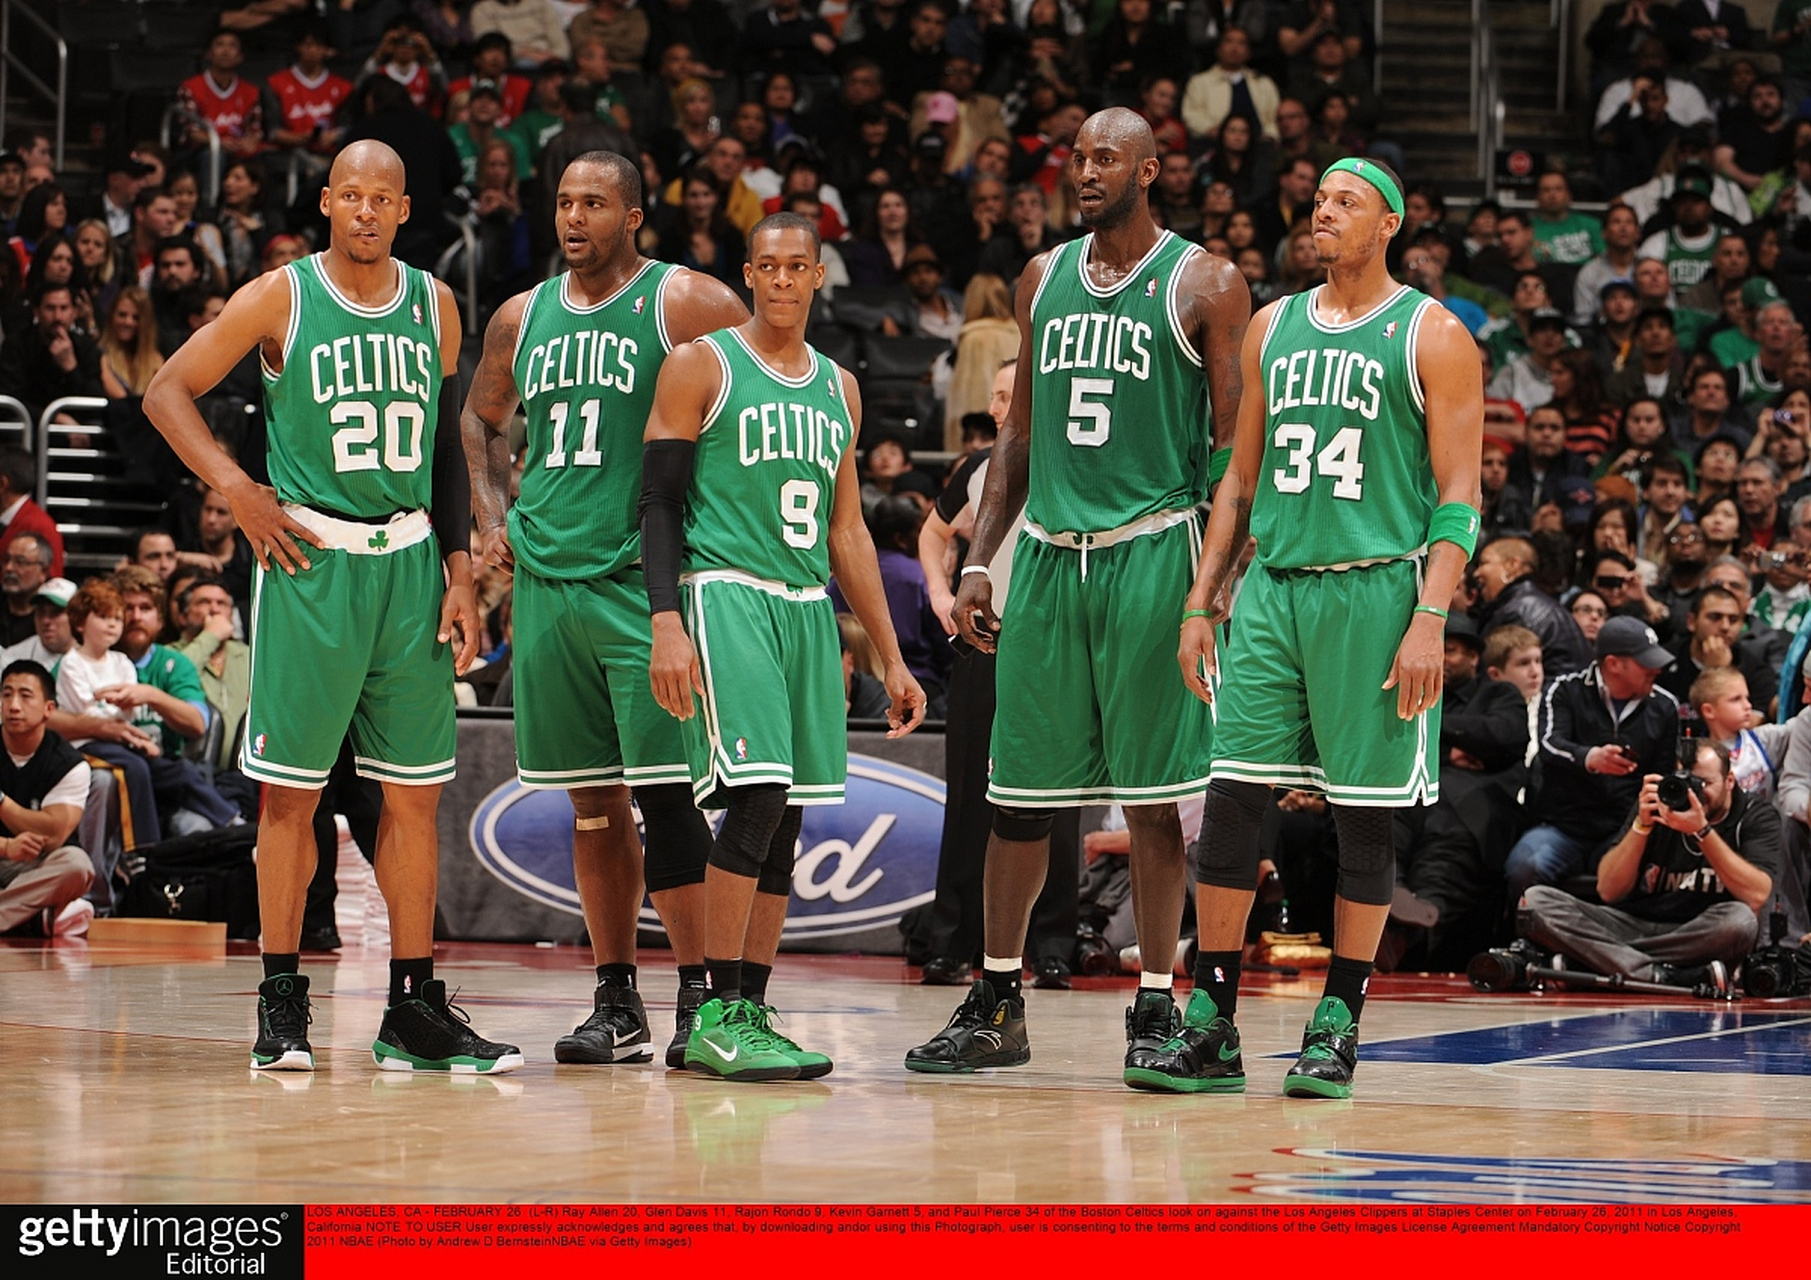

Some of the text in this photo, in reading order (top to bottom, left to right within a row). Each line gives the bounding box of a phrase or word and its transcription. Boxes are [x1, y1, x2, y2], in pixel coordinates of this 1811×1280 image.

[311, 333, 432, 404] CELTICS
[525, 330, 638, 401] CELTICS
[1040, 312, 1153, 381] CELTICS
[1066, 377, 1115, 447] 5
[1269, 348, 1385, 421] CELTICS
[329, 401, 425, 473] 20
[545, 398, 603, 469] 11
[738, 402, 845, 480] CELTICS
[1273, 423, 1364, 501] 34
[780, 479, 820, 550] 9
